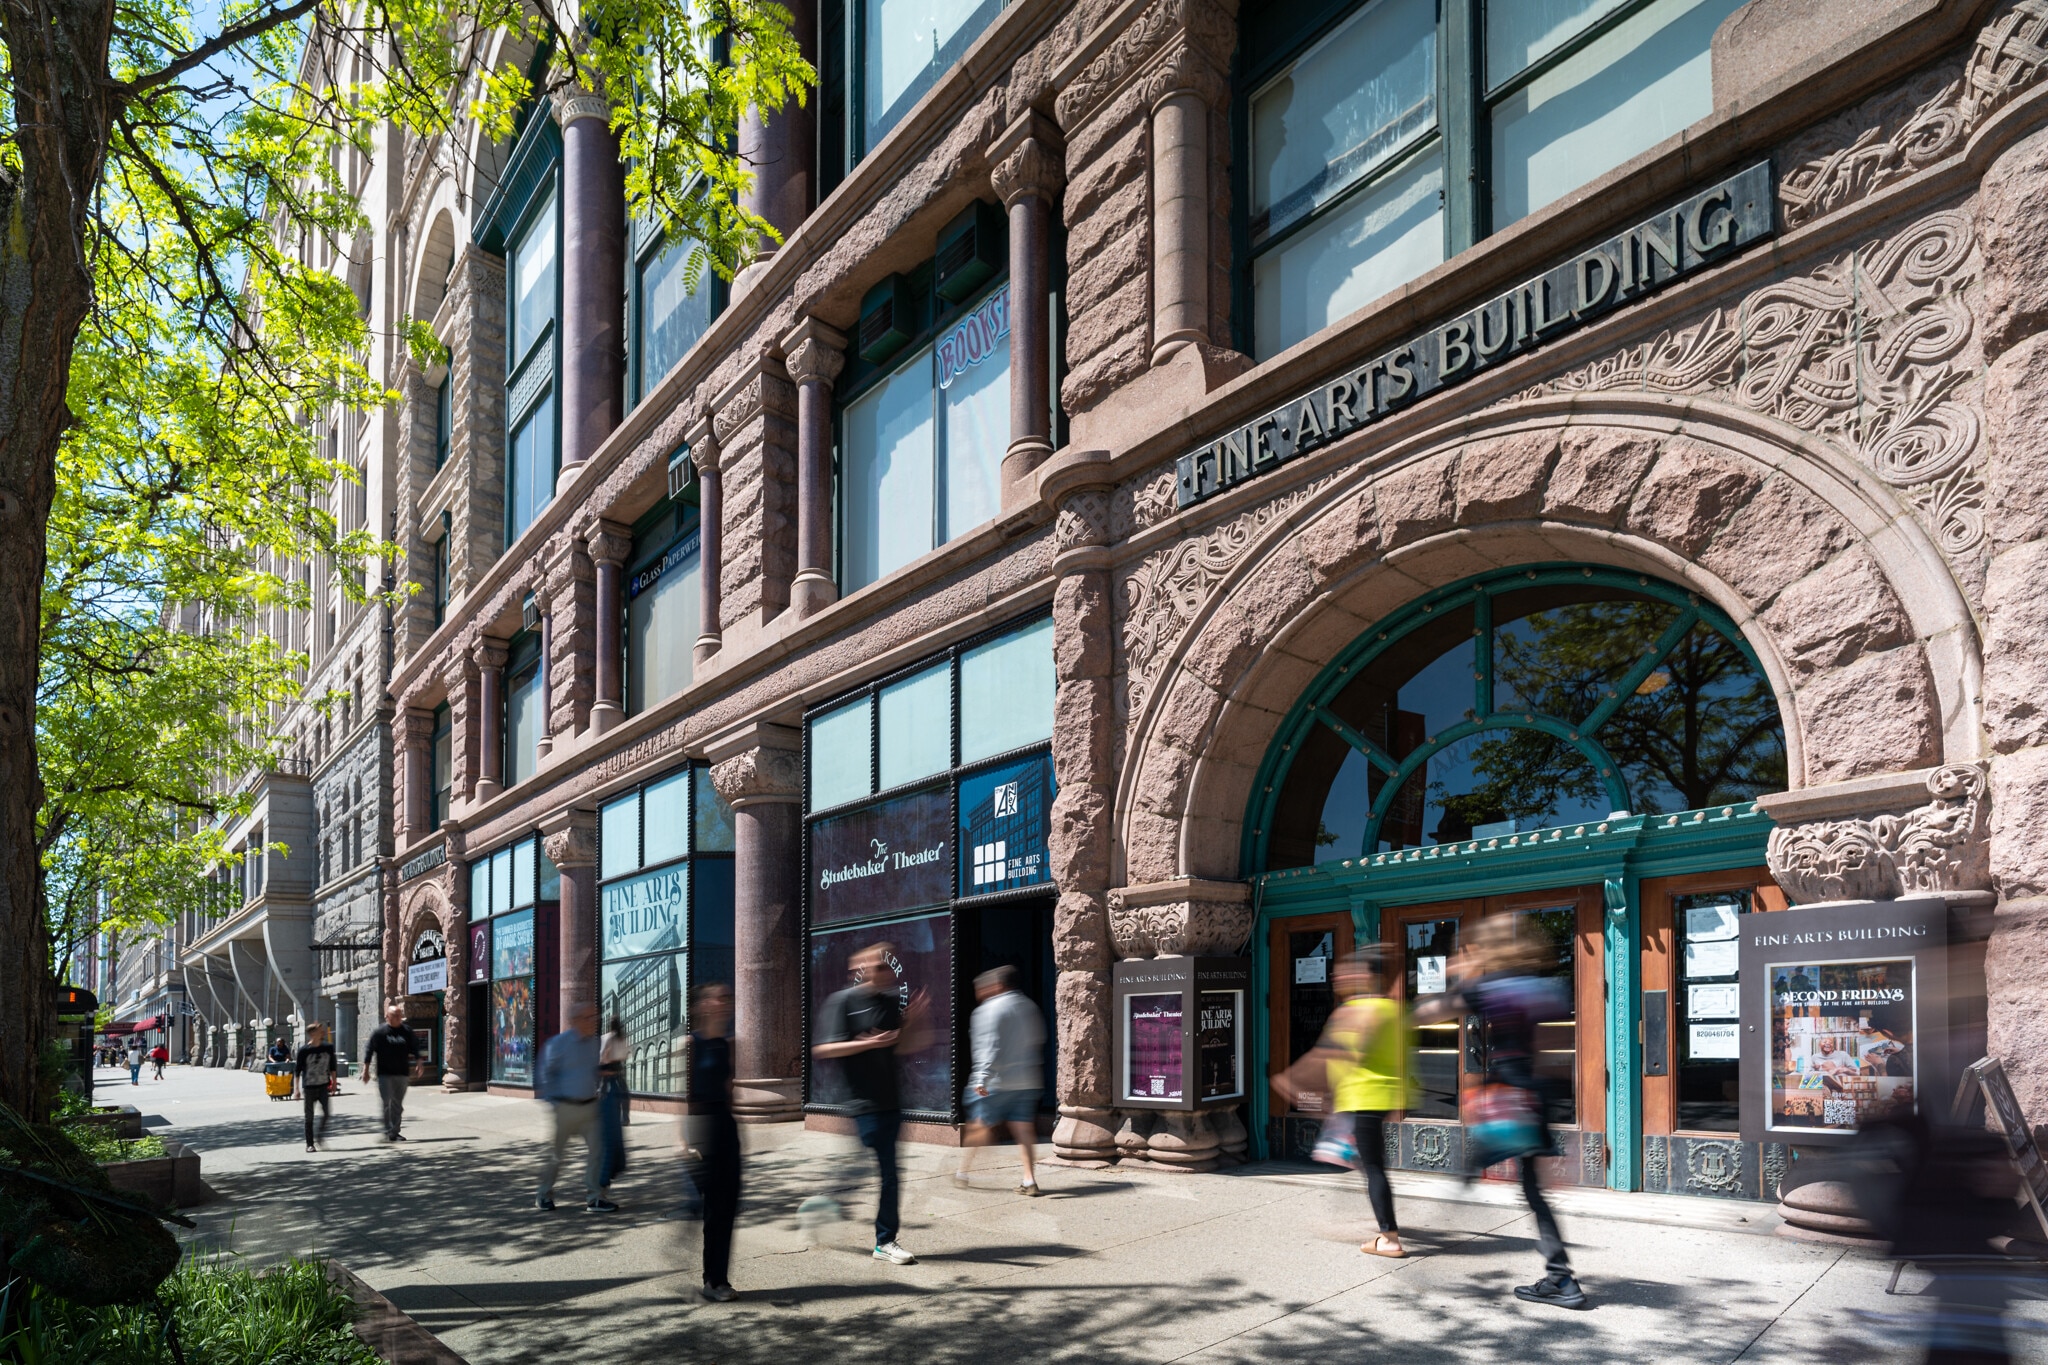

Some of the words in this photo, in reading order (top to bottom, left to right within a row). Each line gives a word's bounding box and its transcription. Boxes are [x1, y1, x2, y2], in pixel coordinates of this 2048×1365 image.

[1190, 427, 1276, 495] FINE
[1296, 345, 1417, 453] ARTS
[1438, 189, 1741, 380] BUILDING
[640, 564, 661, 589] GLASS
[597, 725, 677, 780] STUDEBAKER
[871, 838, 888, 859] The
[820, 855, 889, 890] Studebaker
[892, 841, 944, 870] Theater
[1008, 857, 1022, 869] FINE
[1025, 854, 1040, 865] ARTS
[1008, 865, 1037, 879] BUILDING
[609, 883, 638, 913] FINE
[643, 871, 682, 906] ARTS
[609, 901, 679, 945] BUILDING
[1755, 934, 1790, 947] FINE
[1793, 931, 1833, 944] ARTS
[1838, 925, 1926, 941] BUILDING
[1119, 975, 1134, 984] FINE
[1136, 974, 1152, 982] ARTS
[1152, 972, 1187, 982] BUILDING
[1779, 990, 1838, 1004] SECOND
[1841, 988, 1905, 1002] FRIDAYS
[1201, 1010, 1213, 1020] INE
[1214, 1009, 1233, 1021] ARTS
